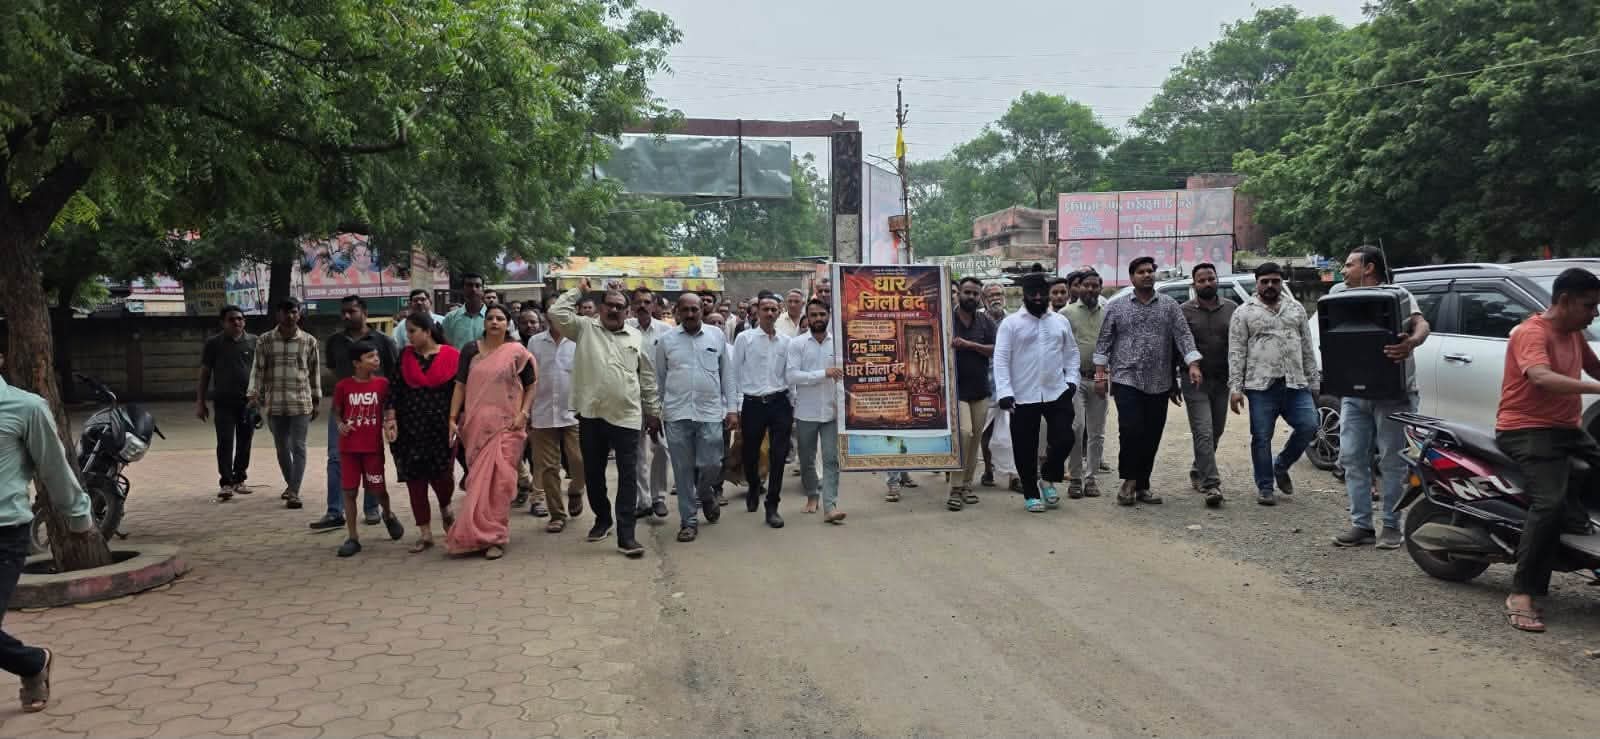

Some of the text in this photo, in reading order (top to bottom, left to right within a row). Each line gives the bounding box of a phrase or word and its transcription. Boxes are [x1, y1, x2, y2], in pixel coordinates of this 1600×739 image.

[873, 276, 908, 291] धार
[858, 291, 928, 311] जिला बंद
[852, 343, 867, 353] 25
[846, 364, 864, 376] धार
[865, 362, 890, 376] जिला
[349, 392, 378, 405] NASA
[366, 473, 384, 483] NASA
